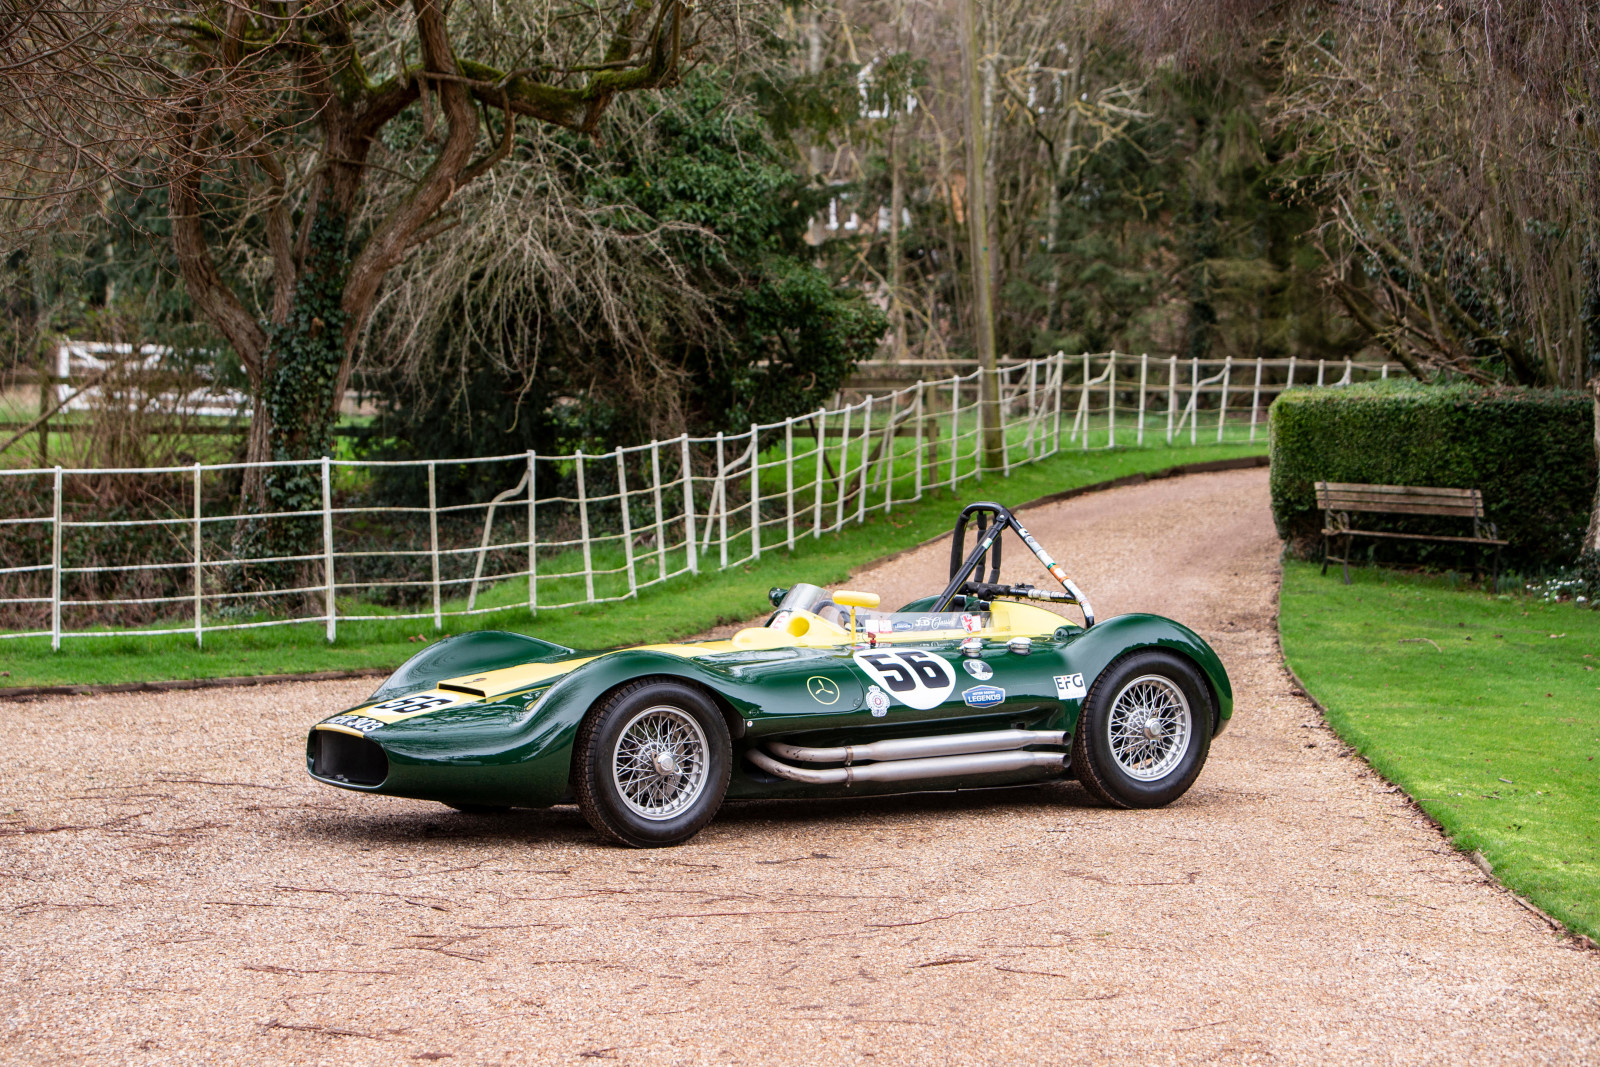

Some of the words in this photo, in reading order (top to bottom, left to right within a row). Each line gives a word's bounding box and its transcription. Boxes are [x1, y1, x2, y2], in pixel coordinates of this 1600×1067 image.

[860, 651, 950, 692] 56
[1055, 674, 1084, 690] EFG
[373, 695, 453, 713] 56
[968, 693, 1001, 703] LEGENDS
